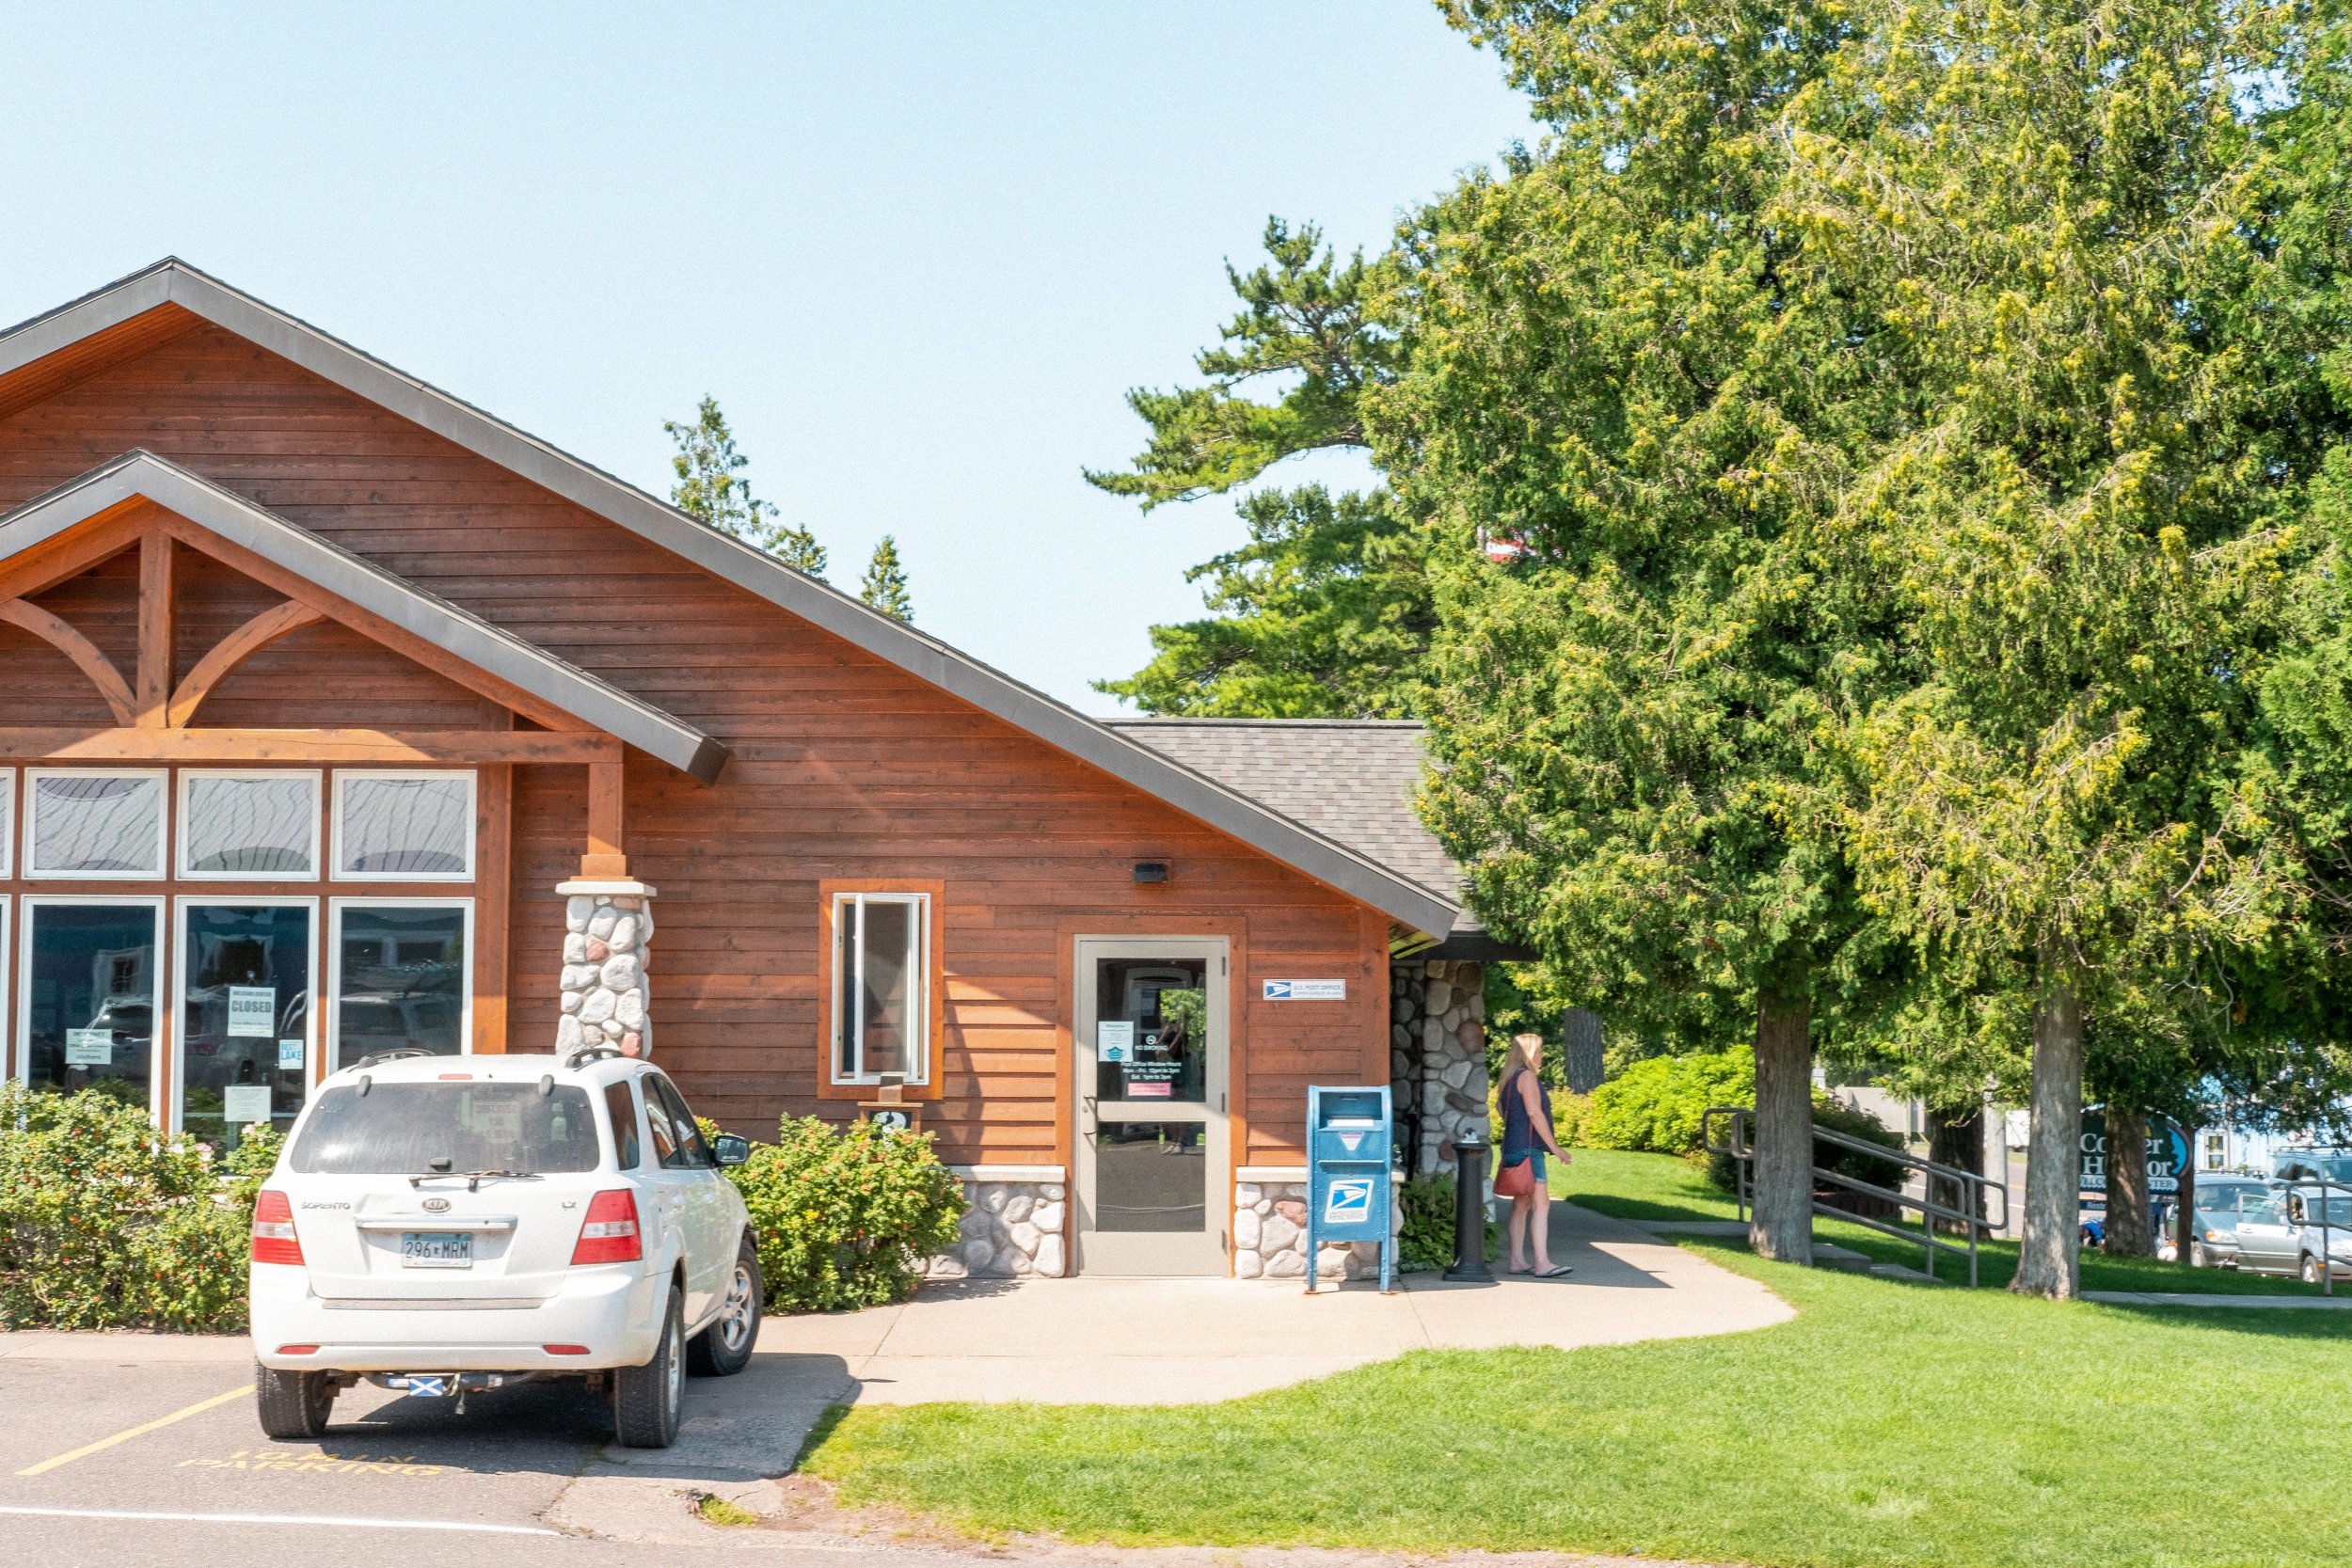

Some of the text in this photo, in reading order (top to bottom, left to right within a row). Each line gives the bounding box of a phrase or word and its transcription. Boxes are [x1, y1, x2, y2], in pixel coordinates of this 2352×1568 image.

[231, 1000, 272, 1013] CLOSED
[2079, 1132, 2164, 1155] Coer
[2082, 1155, 2172, 1177] Hor
[300, 1201, 351, 1211] SORENTO
[174, 1458, 445, 1477] PARKING
